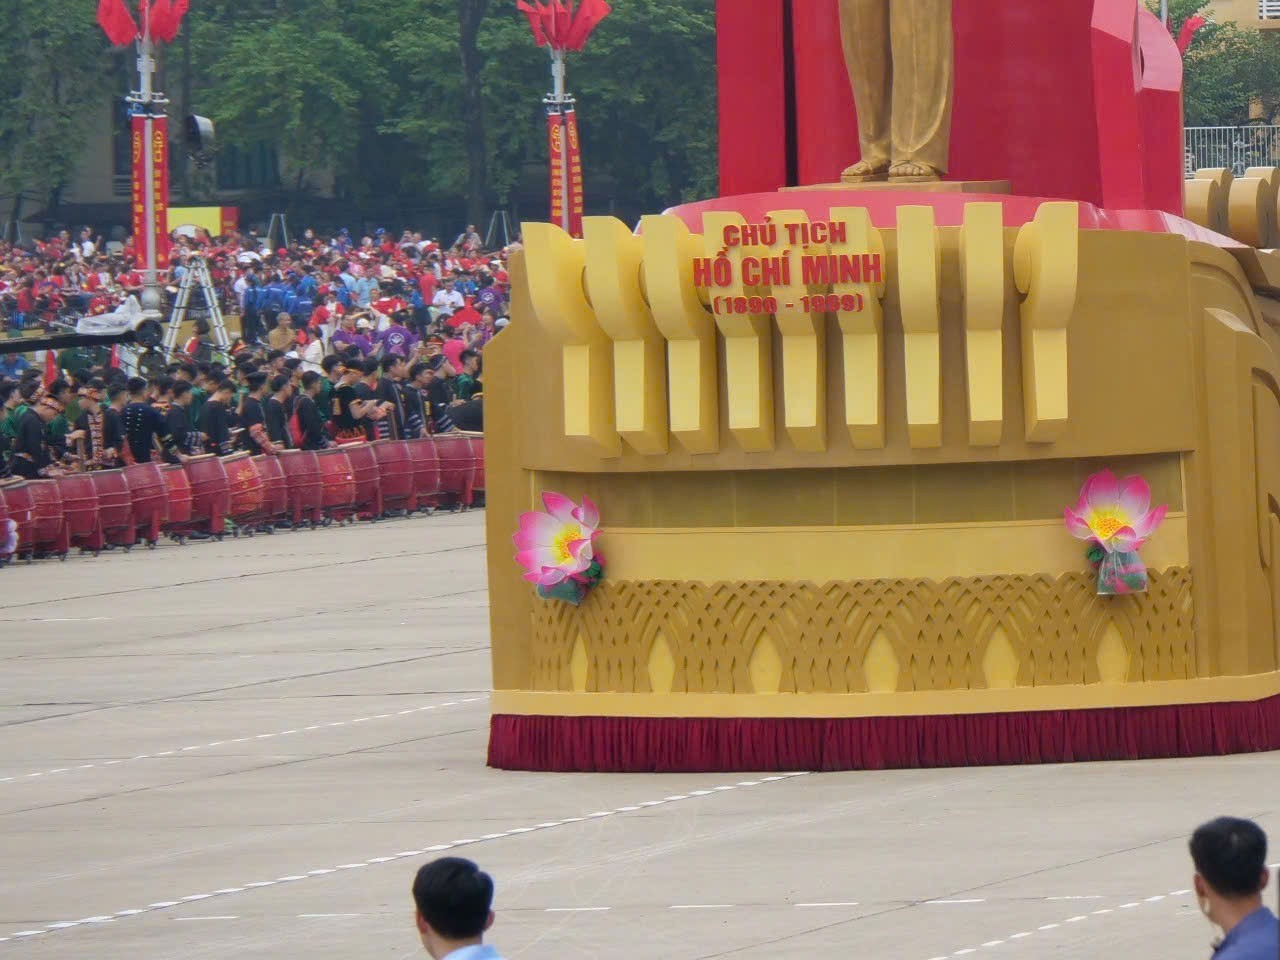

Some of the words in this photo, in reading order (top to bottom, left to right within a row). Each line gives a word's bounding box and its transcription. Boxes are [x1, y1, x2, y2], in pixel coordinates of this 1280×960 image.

[723, 215, 777, 247] CHỦ
[784, 221, 847, 249] TỊCH
[692, 246, 733, 287] HỒ
[741, 250, 791, 287] CHÍ
[802, 253, 883, 286] MINH
[713, 296, 778, 316] (1890
